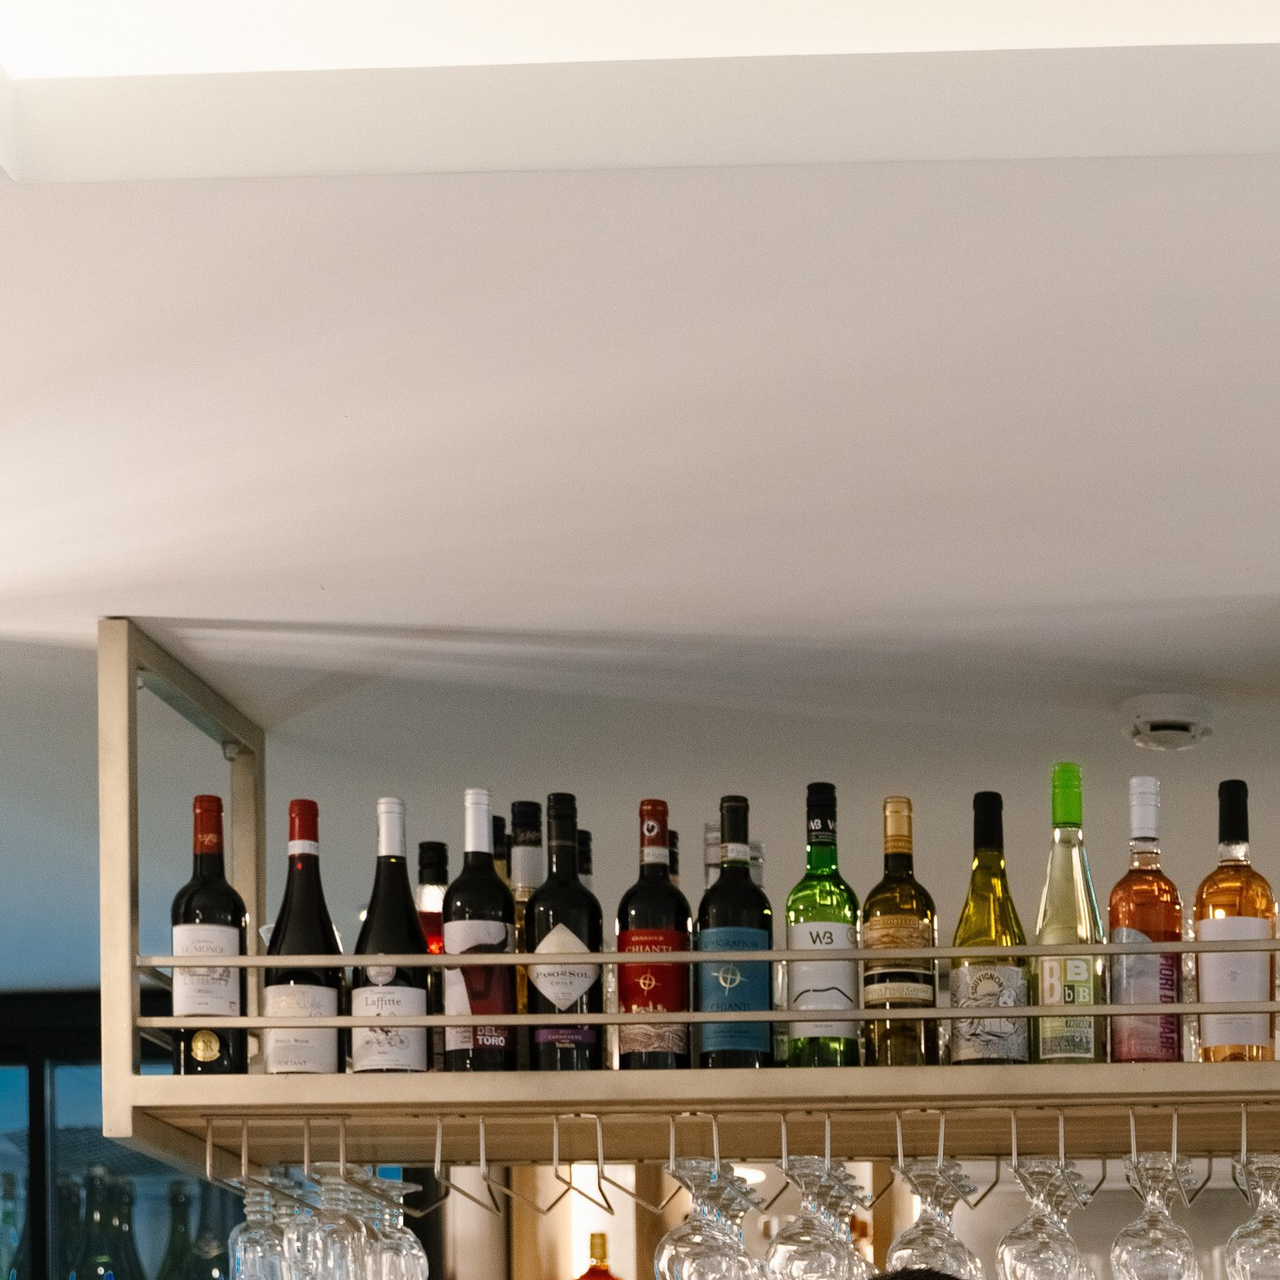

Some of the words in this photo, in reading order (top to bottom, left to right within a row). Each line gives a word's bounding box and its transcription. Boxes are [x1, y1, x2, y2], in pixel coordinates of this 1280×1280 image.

[809, 931, 834, 945] WB
[536, 971, 560, 979] PASO
[364, 996, 402, 1011] Laffitte
[476, 1026, 498, 1036] DEL
[476, 1035, 506, 1047] TORO
